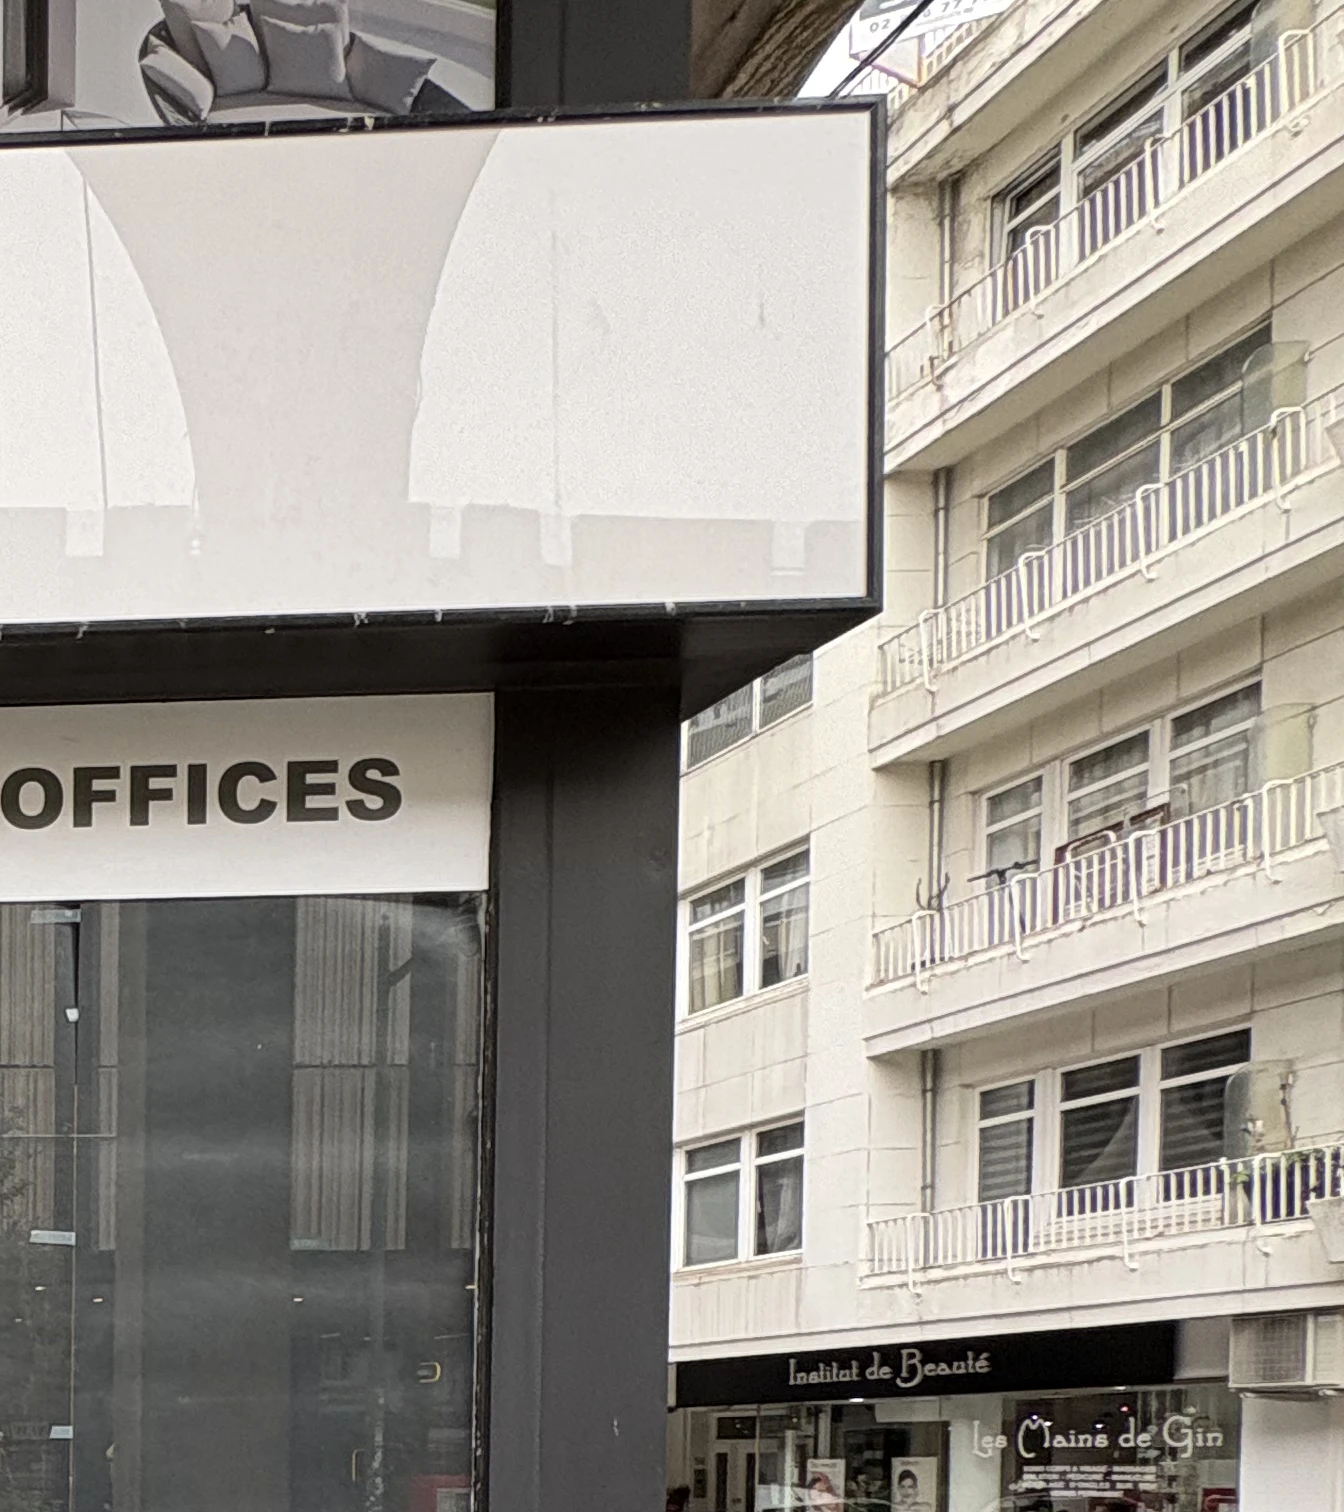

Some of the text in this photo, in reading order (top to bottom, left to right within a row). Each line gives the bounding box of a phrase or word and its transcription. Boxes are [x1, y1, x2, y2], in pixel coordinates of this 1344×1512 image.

[0, 758, 404, 827] OFFICES
[788, 1349, 992, 1388] Institut de Beauté
[972, 1415, 1223, 1458] Les Mains de Gin
